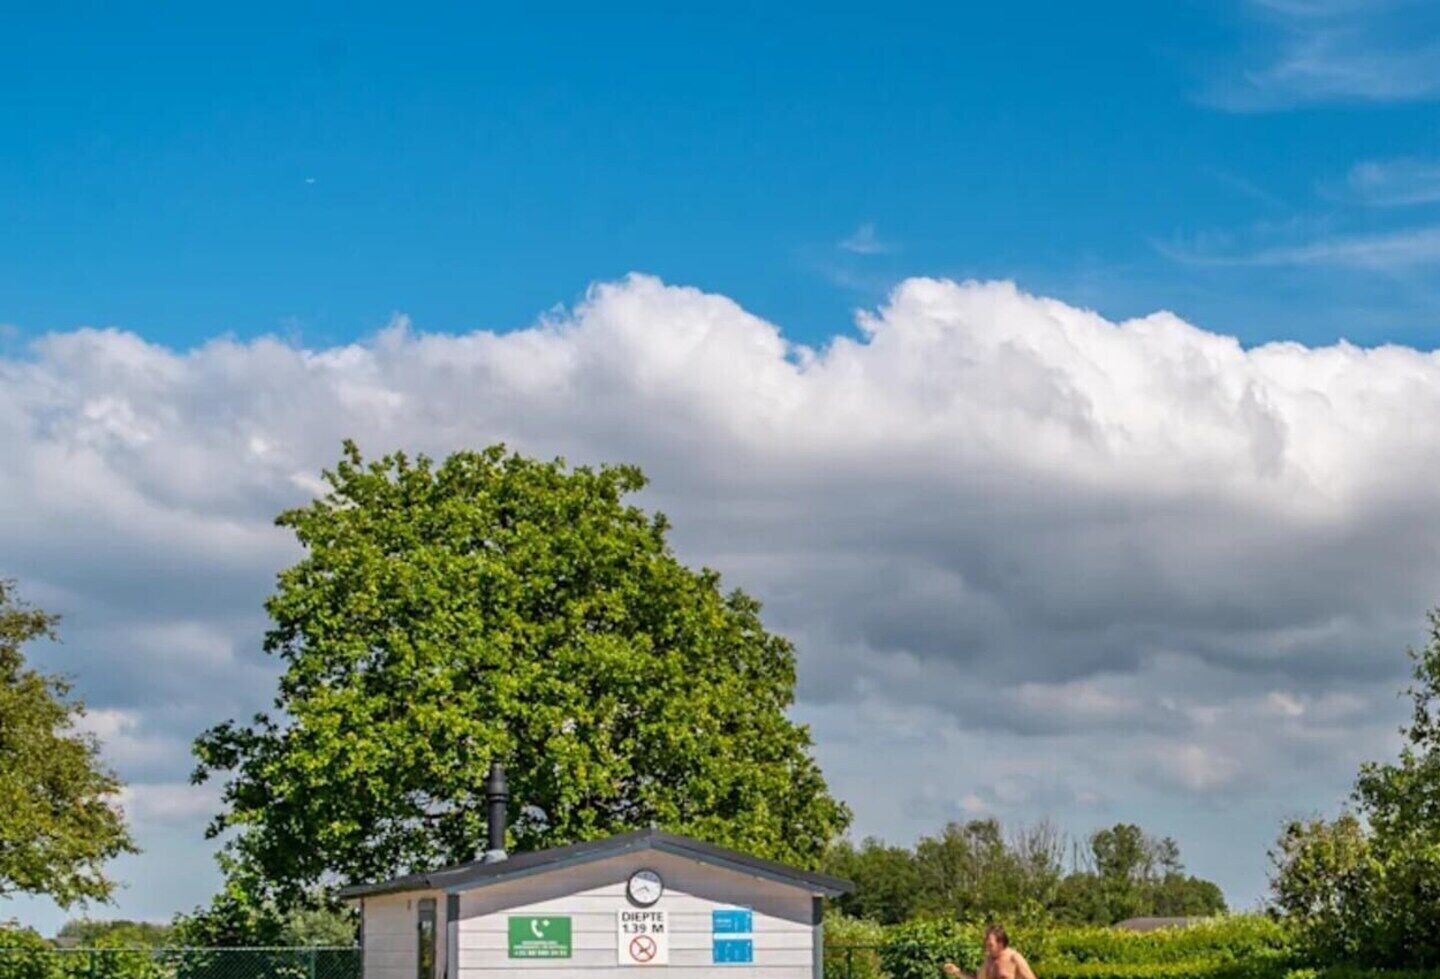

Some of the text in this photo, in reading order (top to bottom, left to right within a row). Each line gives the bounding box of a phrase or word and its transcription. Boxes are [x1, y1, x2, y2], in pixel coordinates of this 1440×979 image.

[621, 911, 664, 922] DIEPTE
[622, 923, 664, 934] 1.39 M
